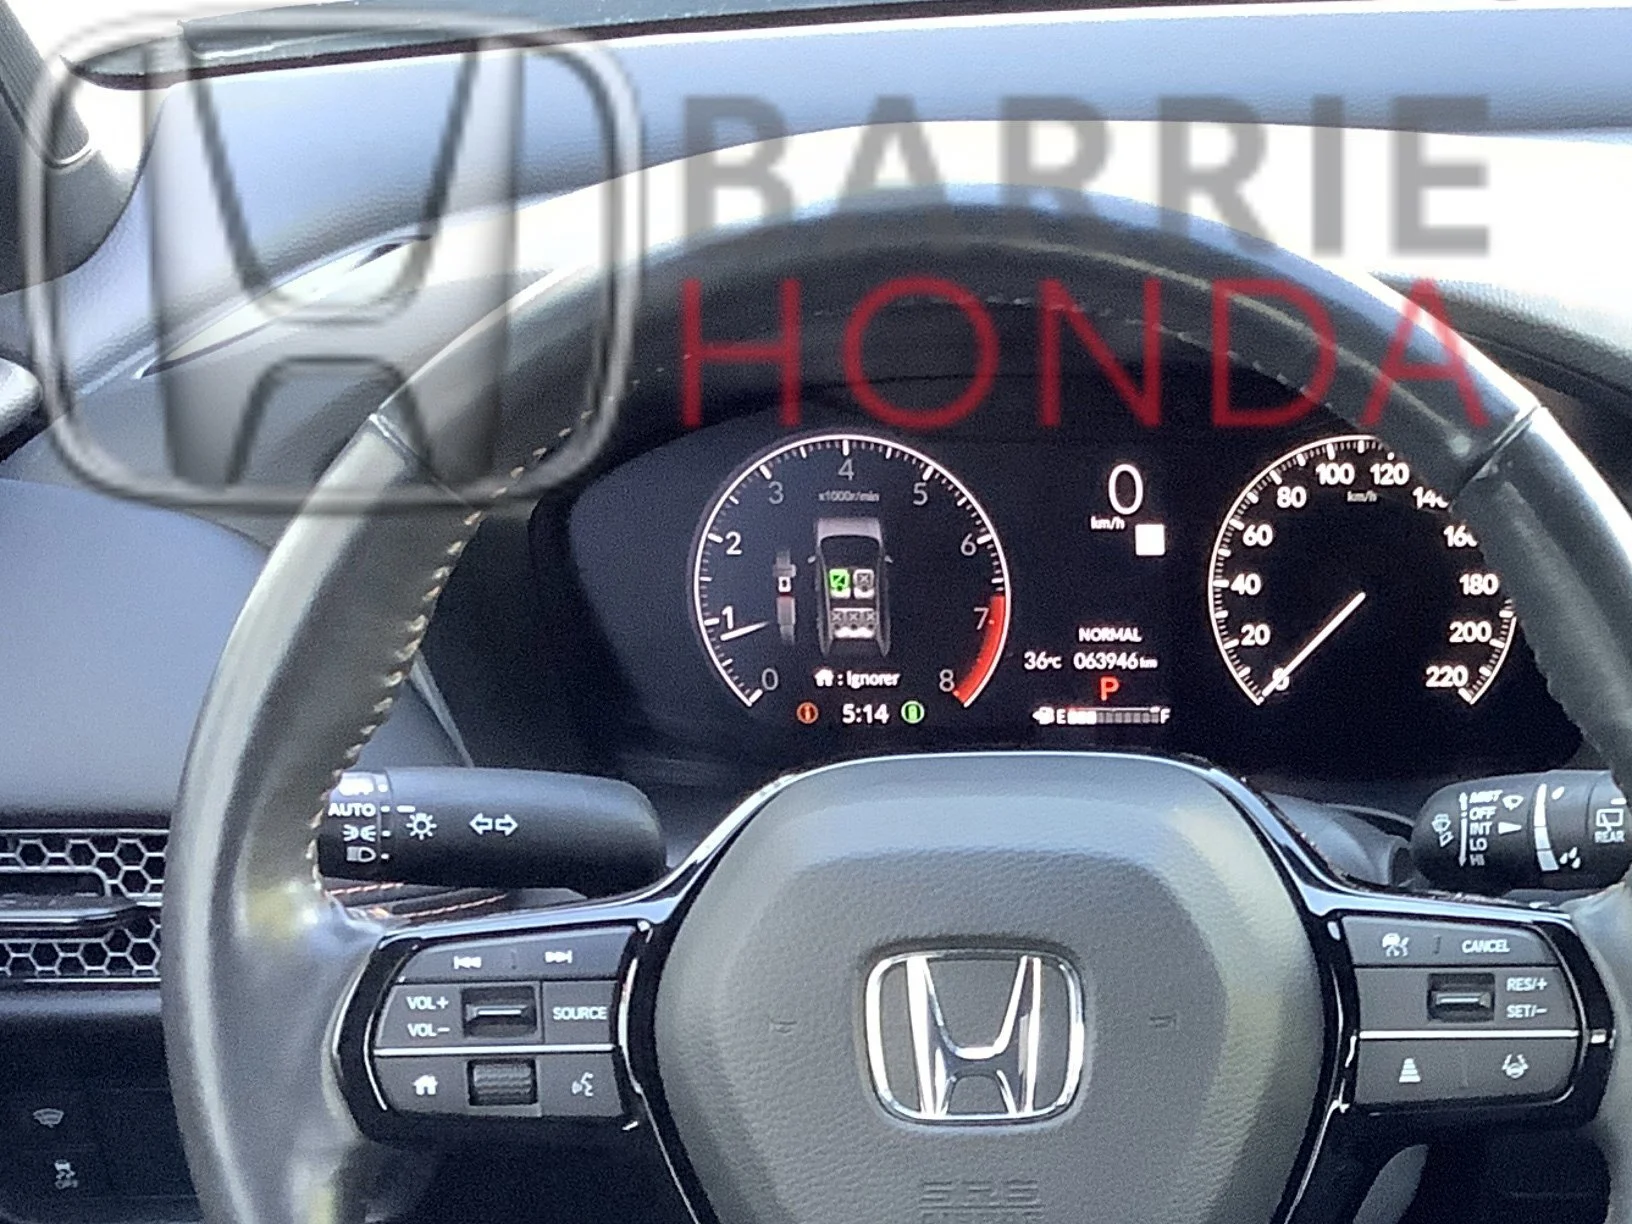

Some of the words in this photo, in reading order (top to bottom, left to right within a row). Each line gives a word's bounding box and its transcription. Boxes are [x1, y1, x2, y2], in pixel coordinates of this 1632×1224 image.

[838, 460, 855, 481] 4
[1315, 462, 1355, 486] 100
[1370, 462, 1409, 486] 120
[769, 482, 784, 505] 3
[913, 483, 928, 506] 5
[1108, 464, 1143, 515] 0
[1276, 486, 1307, 509] 80
[1347, 491, 1377, 503] km/h
[1091, 516, 1125, 530] km/h
[725, 532, 742, 554] 2
[961, 534, 976, 556] 6
[1242, 525, 1273, 547] 60
[1230, 574, 1262, 596] 40
[1459, 574, 1499, 596] 180
[722, 606, 733, 630] 1
[973, 608, 989, 630] 7
[1078, 627, 1142, 643] NORMAL
[1240, 624, 1271, 647] 20
[1449, 622, 1492, 644] 200
[1073, 652, 1139, 670] 063946
[762, 668, 779, 691] 0
[847, 672, 899, 687] Ignorer
[939, 669, 955, 692] 8
[1425, 665, 1469, 688] 220
[1100, 676, 1120, 701] P
[842, 704, 890, 724] 5:14
[1056, 708, 1066, 724] E
[1160, 707, 1171, 724] F
[327, 802, 377, 817] AUTO
[1469, 806, 1497, 821] OFF
[1469, 821, 1493, 836] INT
[1594, 831, 1626, 844] REAR
[1469, 838, 1488, 851] LO
[1469, 853, 1486, 867] HI
[1461, 939, 1511, 953] CANCEL
[552, 1006, 608, 1021] SOURCE
